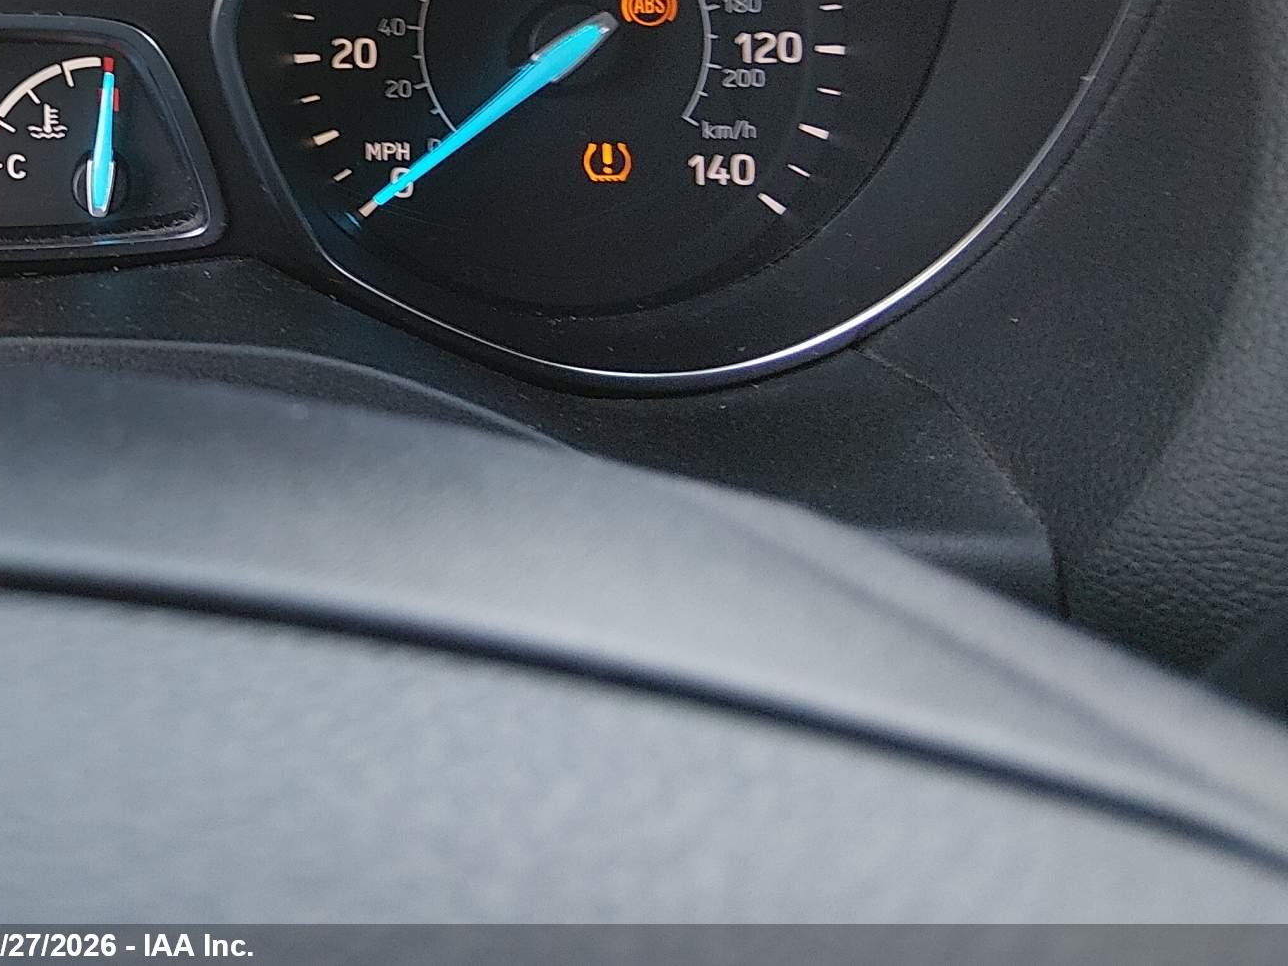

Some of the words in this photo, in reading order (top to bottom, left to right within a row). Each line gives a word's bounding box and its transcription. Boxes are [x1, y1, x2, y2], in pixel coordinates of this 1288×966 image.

[377, 17, 406, 36] 40
[332, 37, 378, 69] 20
[734, 31, 803, 64] 120
[722, 68, 766, 88] 200
[385, 79, 412, 99] 20
[702, 120, 757, 140] km/h
[365, 141, 411, 161] MPH
[6, 153, 26, 179] C
[687, 153, 756, 186] 140
